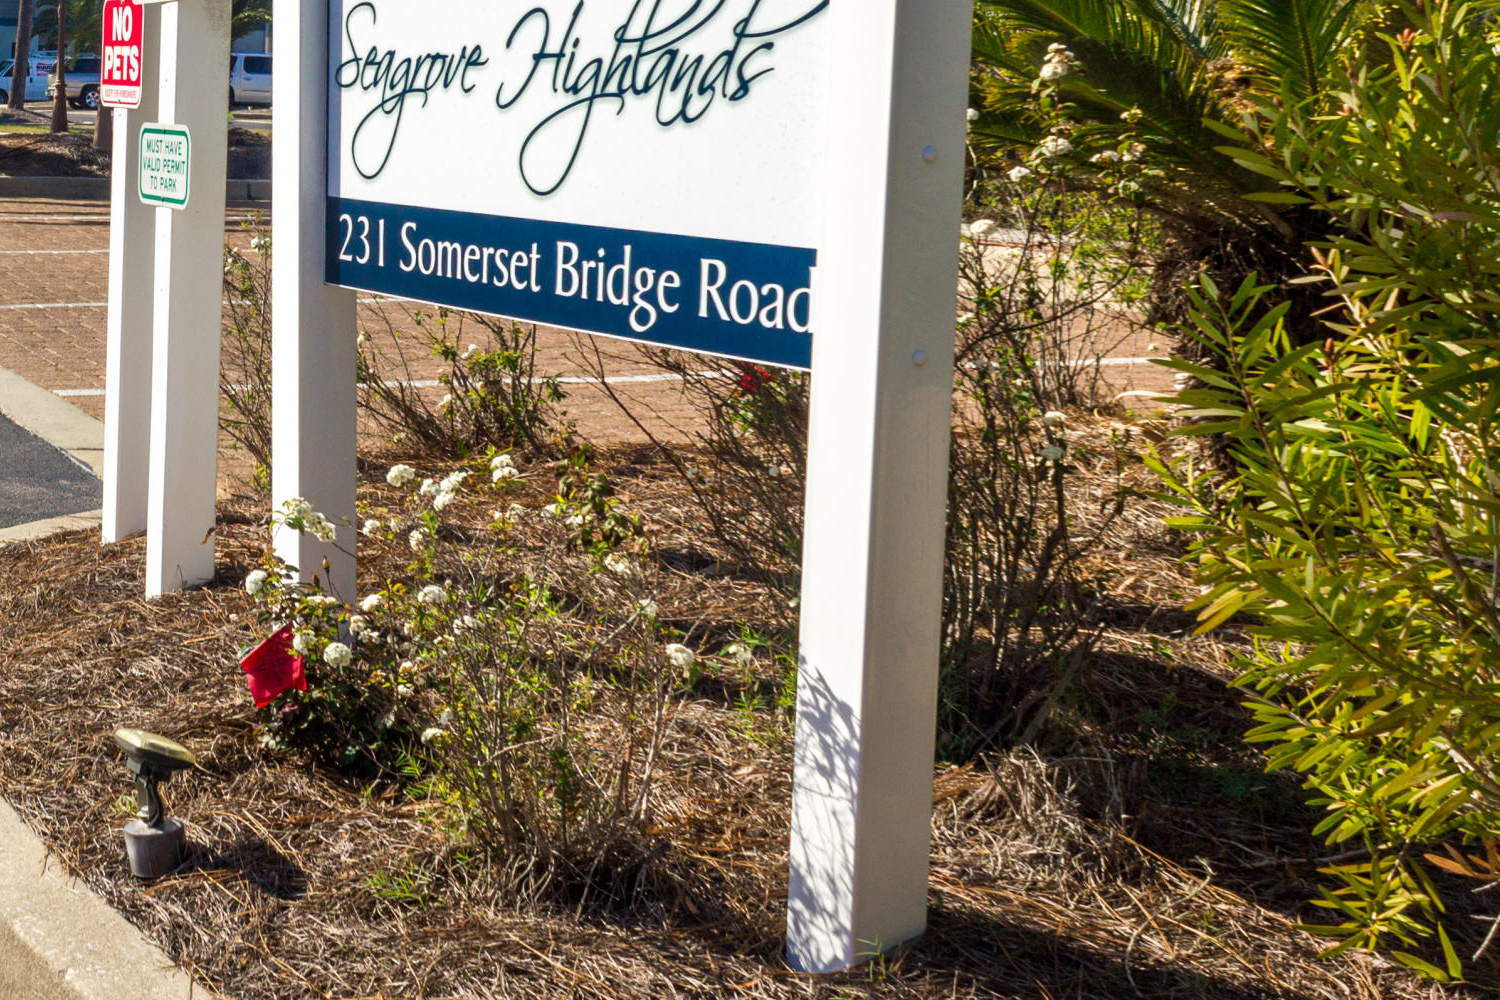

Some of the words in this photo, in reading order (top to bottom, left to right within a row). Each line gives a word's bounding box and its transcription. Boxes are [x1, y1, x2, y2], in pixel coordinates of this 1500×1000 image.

[112, 5, 133, 42] NO
[104, 44, 139, 82] PETS
[336, 1, 489, 180] Seagrove
[143, 157, 160, 172] VALID
[162, 159, 186, 175] PERMIT
[146, 139, 163, 154] MUST
[165, 140, 182, 156] HAVE
[150, 176, 158, 190] TO
[160, 177, 177, 192] PARK
[338, 213, 385, 267] 231
[399, 222, 540, 292] Somerset
[554, 239, 681, 333] Bridge
[698, 257, 814, 334] Road
